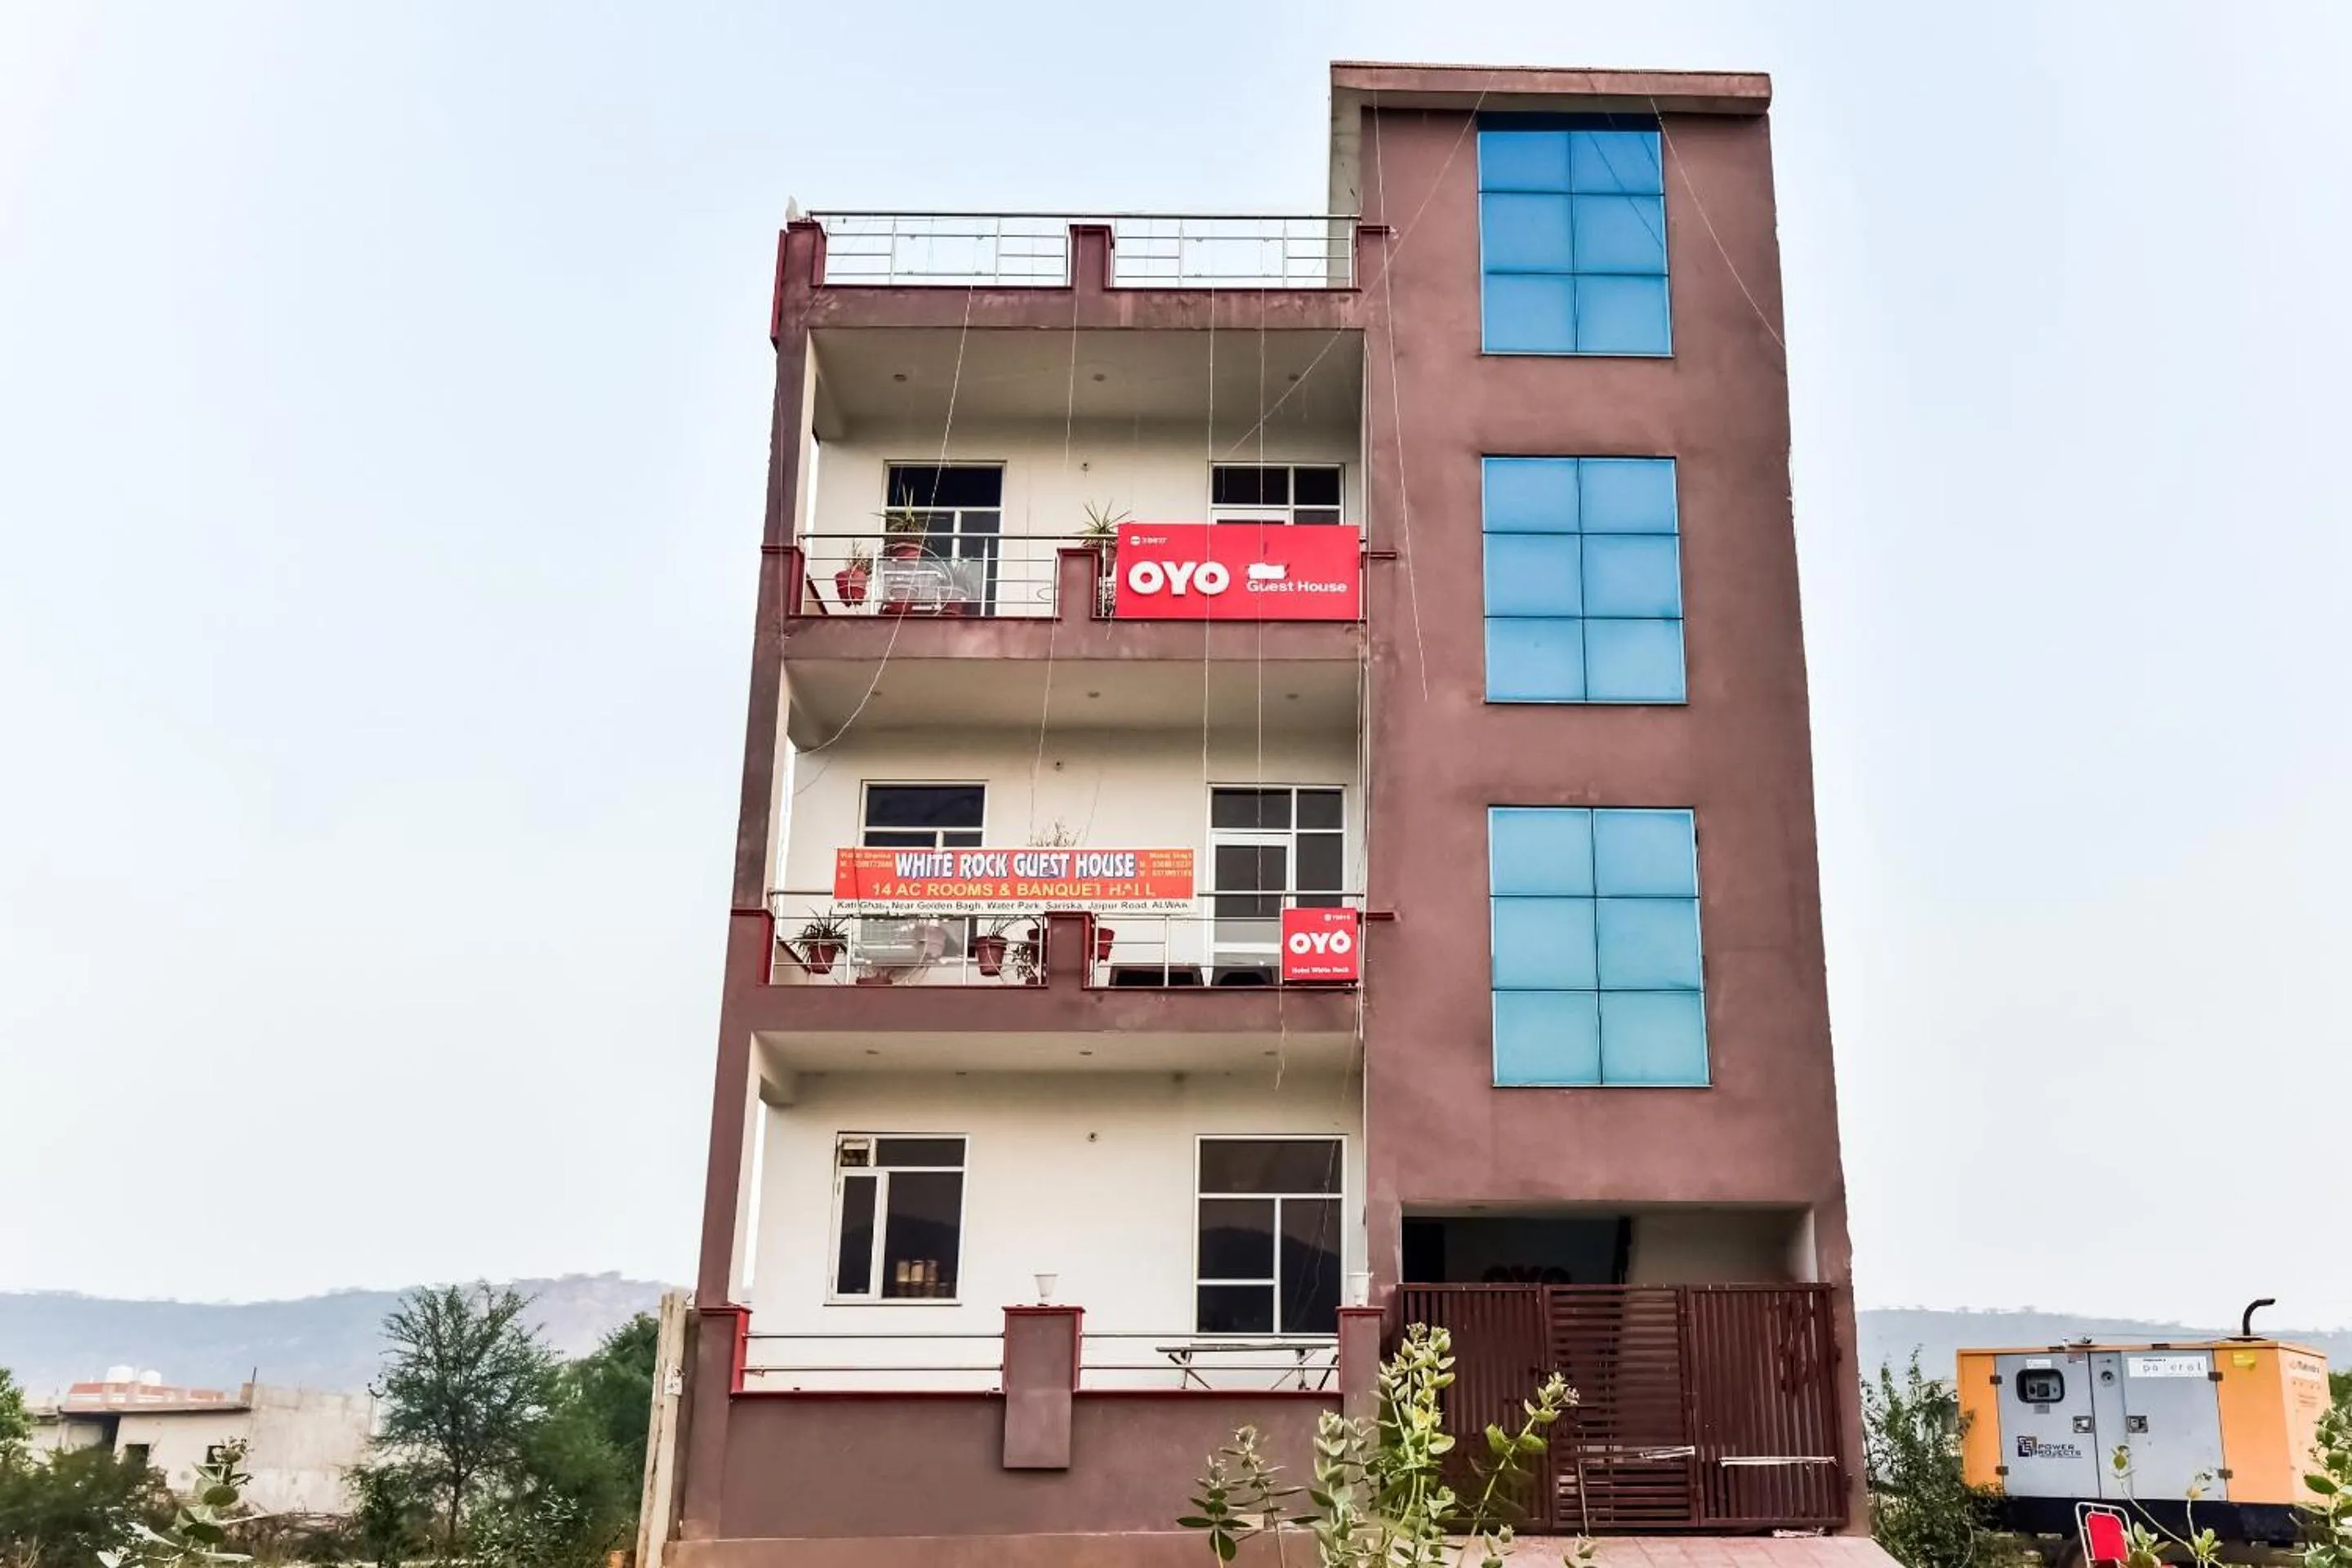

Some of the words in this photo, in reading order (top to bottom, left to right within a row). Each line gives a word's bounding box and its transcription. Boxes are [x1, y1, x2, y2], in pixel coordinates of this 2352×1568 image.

[1128, 560, 1230, 595] OYO
[1247, 581, 1294, 593] Guest
[1298, 581, 1347, 593] House
[895, 853, 954, 879] WHITE
[960, 853, 1009, 879] ROCK
[1013, 853, 1070, 878] GUEST
[1075, 853, 1135, 878] HOUSE
[872, 883, 892, 896] 14
[895, 883, 922, 896] AC
[927, 883, 994, 896] ROOMS
[999, 883, 1012, 896] &
[1017, 883, 1102, 896] BANQUET
[892, 901, 914, 909] Near
[917, 901, 952, 910] Golden
[987, 901, 1015, 910] Water
[1289, 930, 1352, 955] OYO
